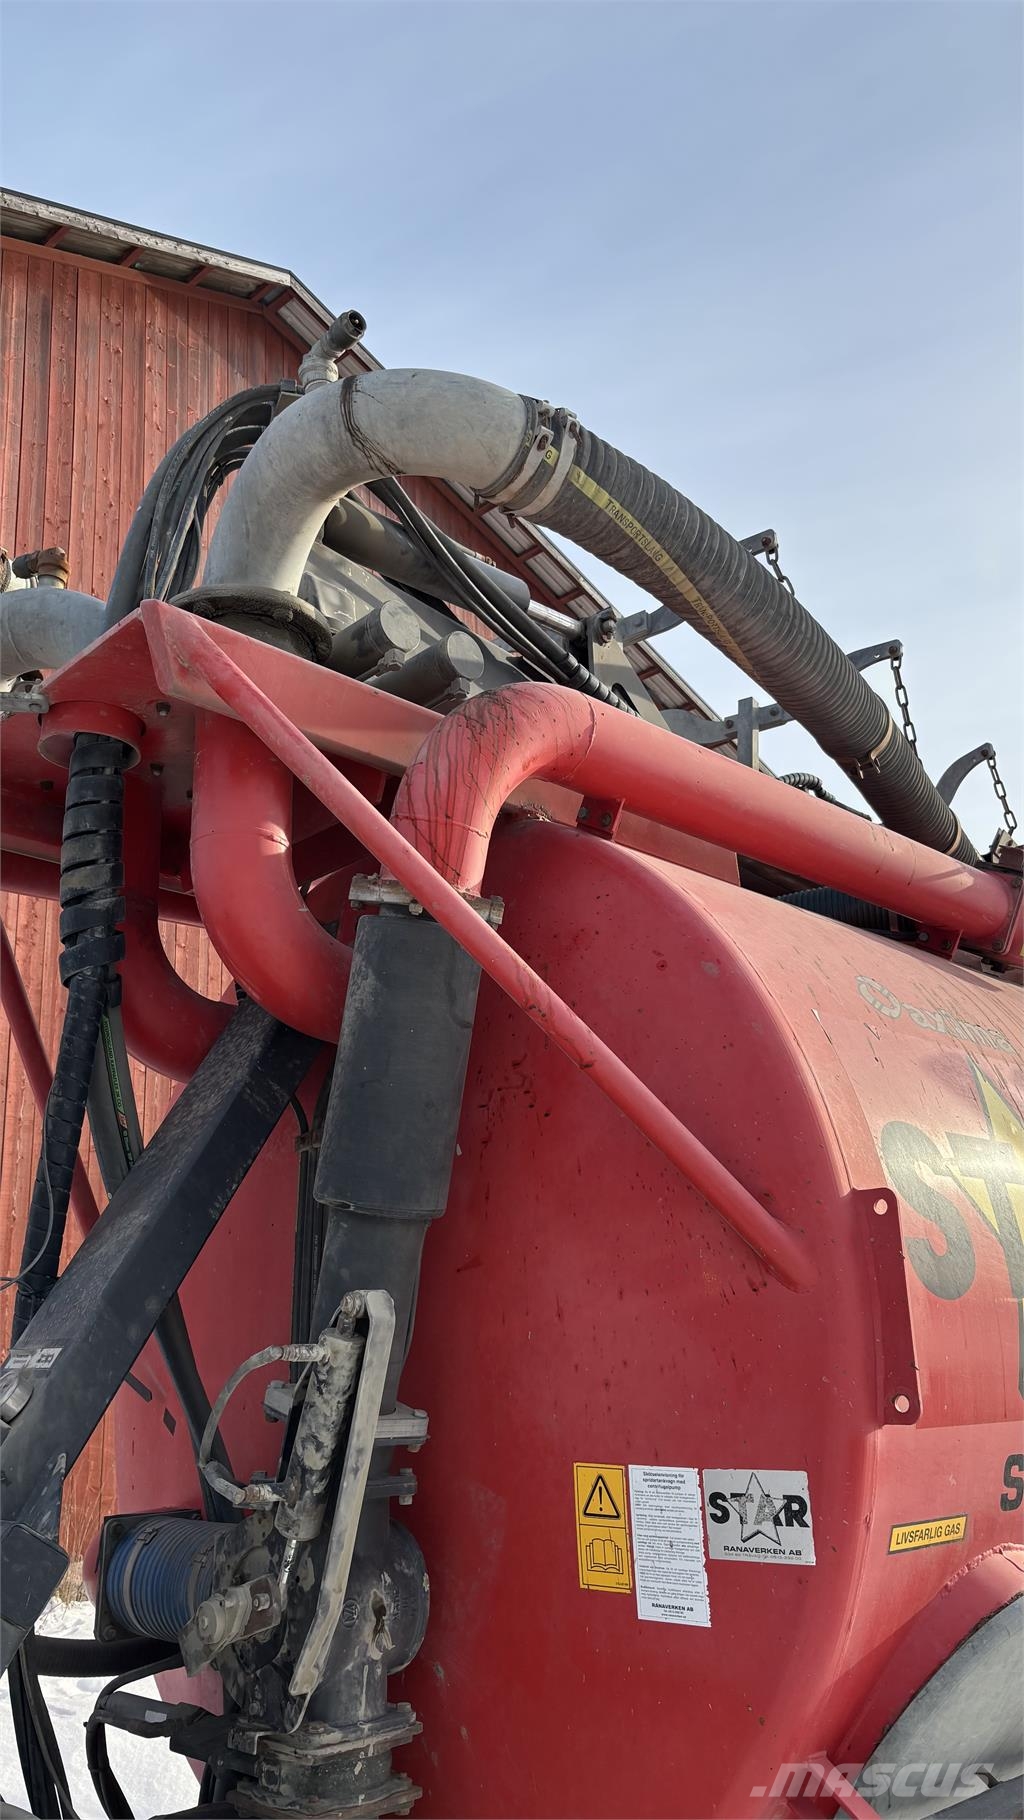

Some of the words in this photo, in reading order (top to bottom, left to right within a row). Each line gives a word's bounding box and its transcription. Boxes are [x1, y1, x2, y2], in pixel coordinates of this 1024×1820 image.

[708, 1491, 811, 1529] STAR
[895, 1525, 942, 1545] LIVSFARLIG
[944, 1522, 961, 1536] GAS
[723, 1545, 786, 1555] RANAVERKEN
